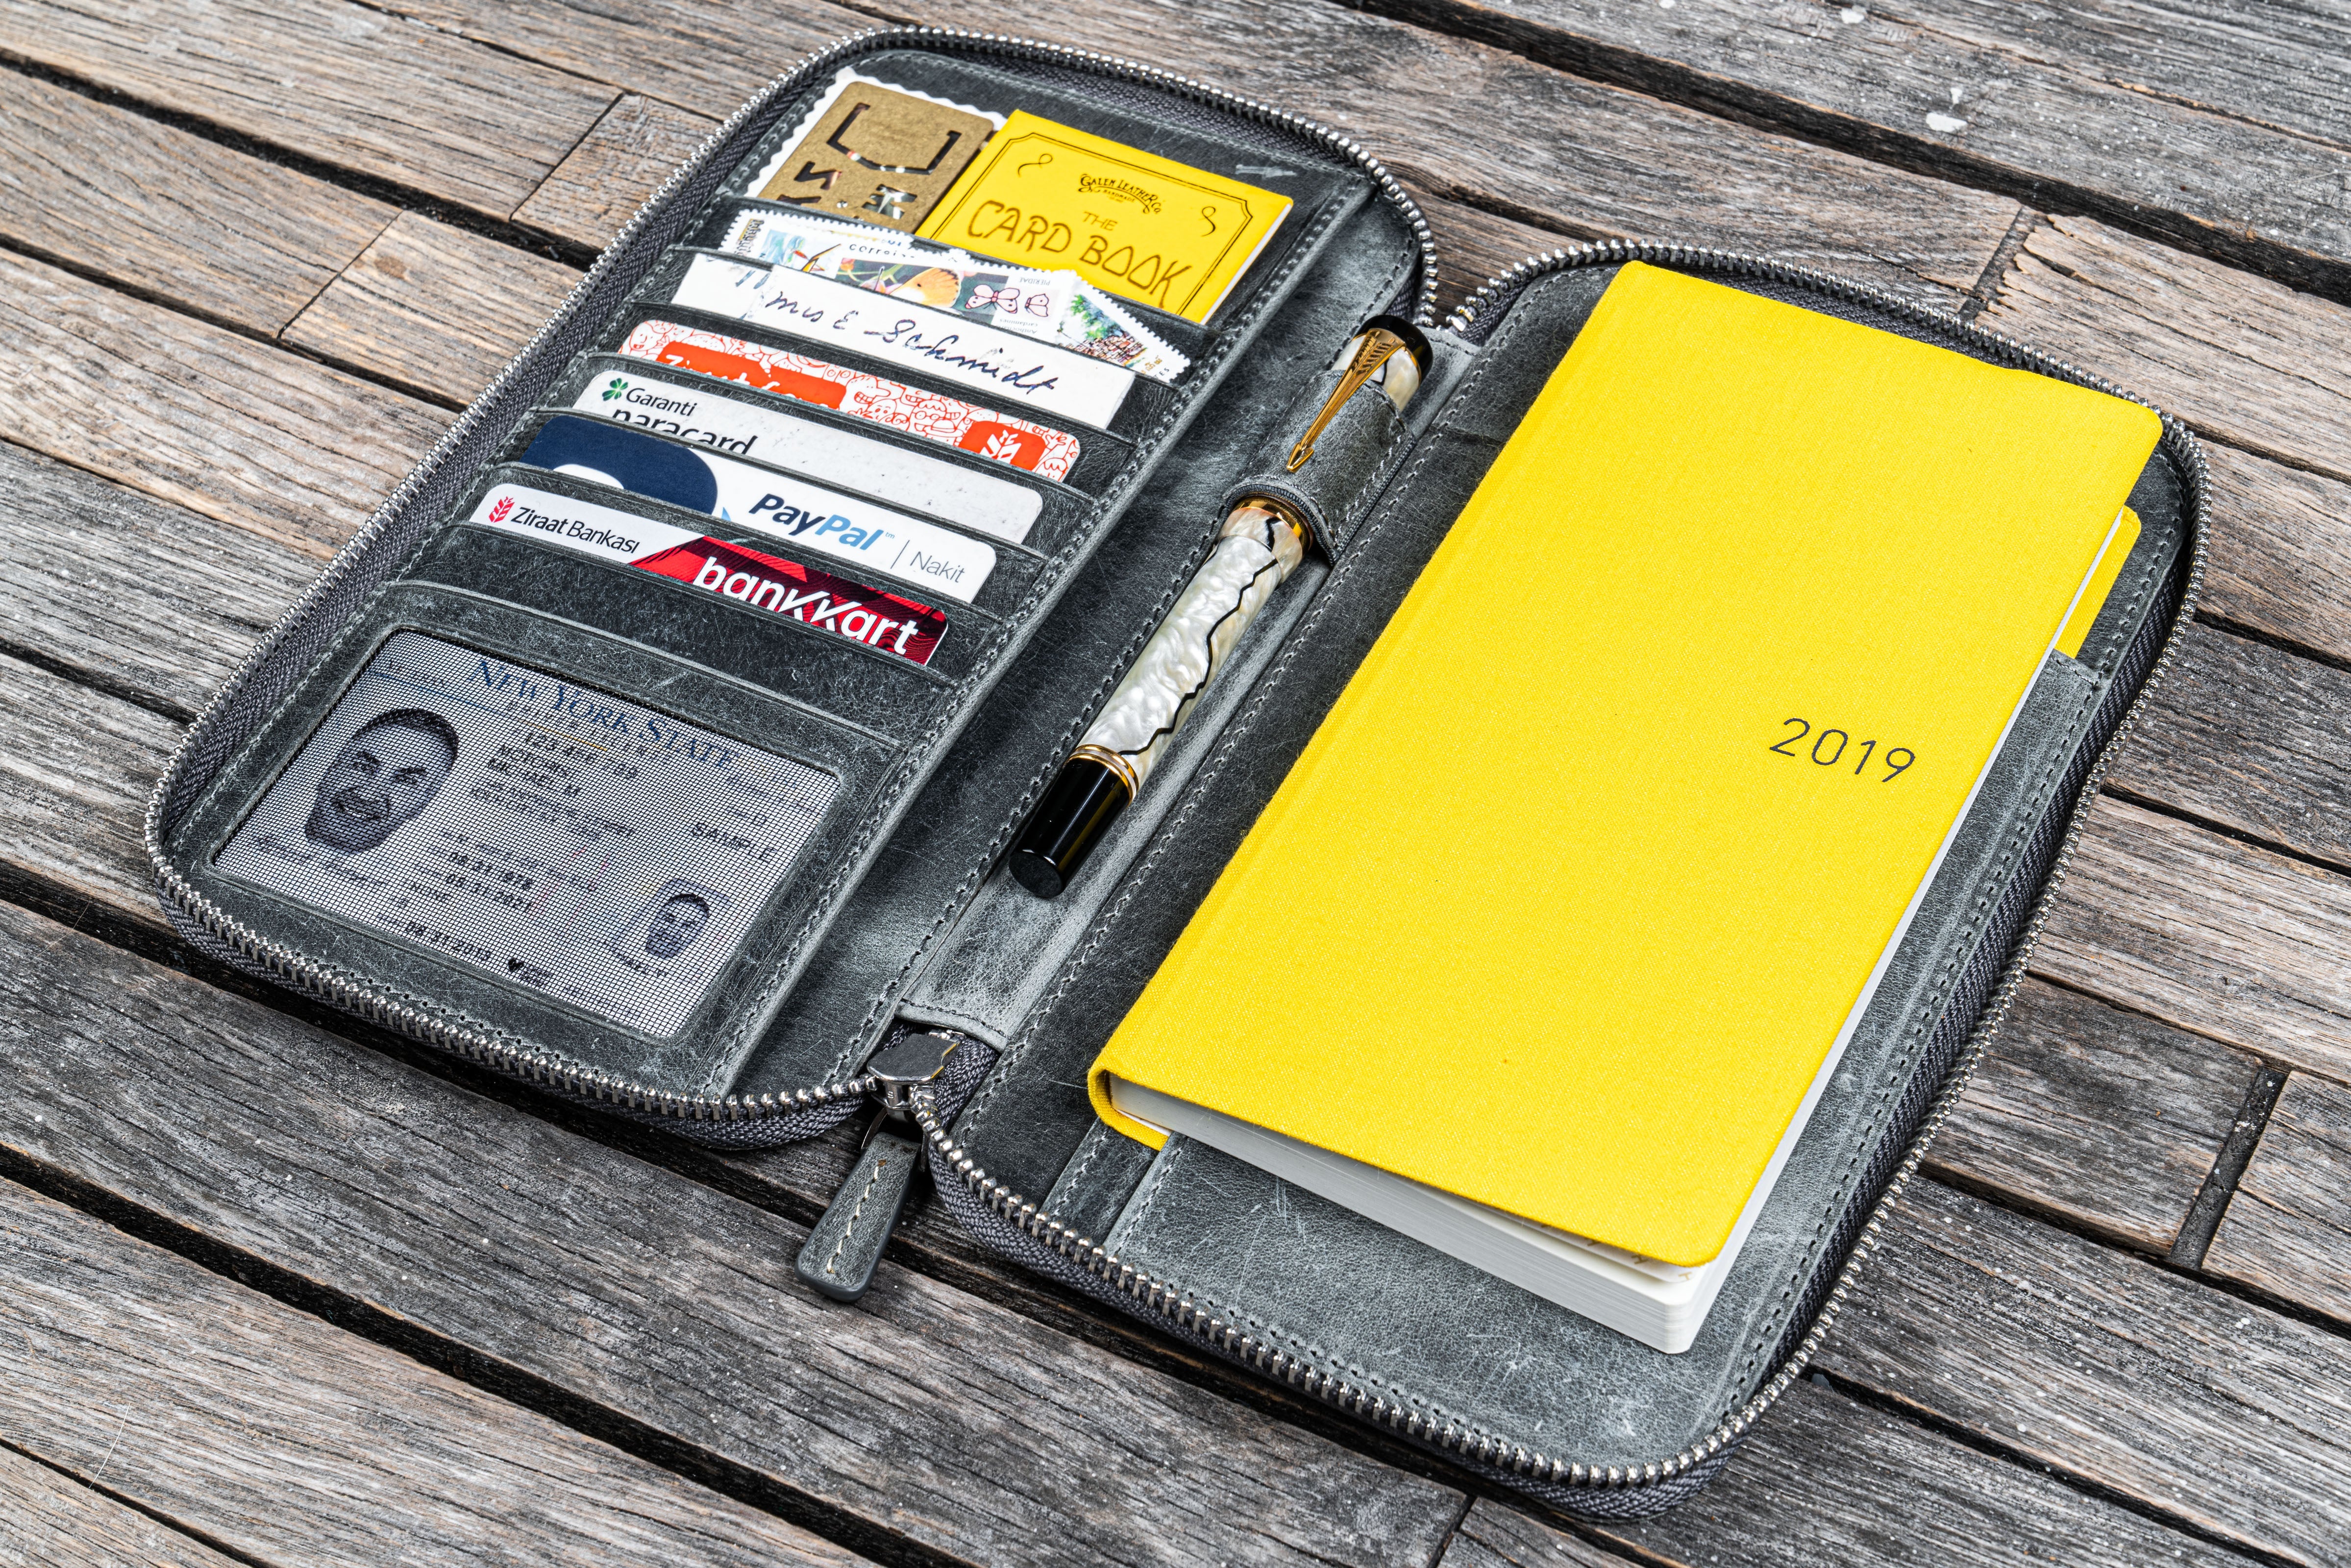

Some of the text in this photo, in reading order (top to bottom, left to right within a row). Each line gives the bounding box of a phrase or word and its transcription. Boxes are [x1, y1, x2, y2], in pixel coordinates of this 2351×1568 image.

[1117, 180, 1158, 206] LEATHER
[1084, 211, 1118, 231] THE
[966, 199, 1192, 310] CARD BOOK
[1019, 277, 1051, 286] PIERIDAE
[626, 388, 697, 416] Garanti
[510, 506, 640, 554] Ziraat Bankası
[748, 493, 884, 551] PayPal
[910, 551, 965, 583] Nakit
[467, 660, 744, 772] NEW YORK STATE
[1770, 718, 1915, 783] 2019
[688, 821, 779, 864] SAMPLE
